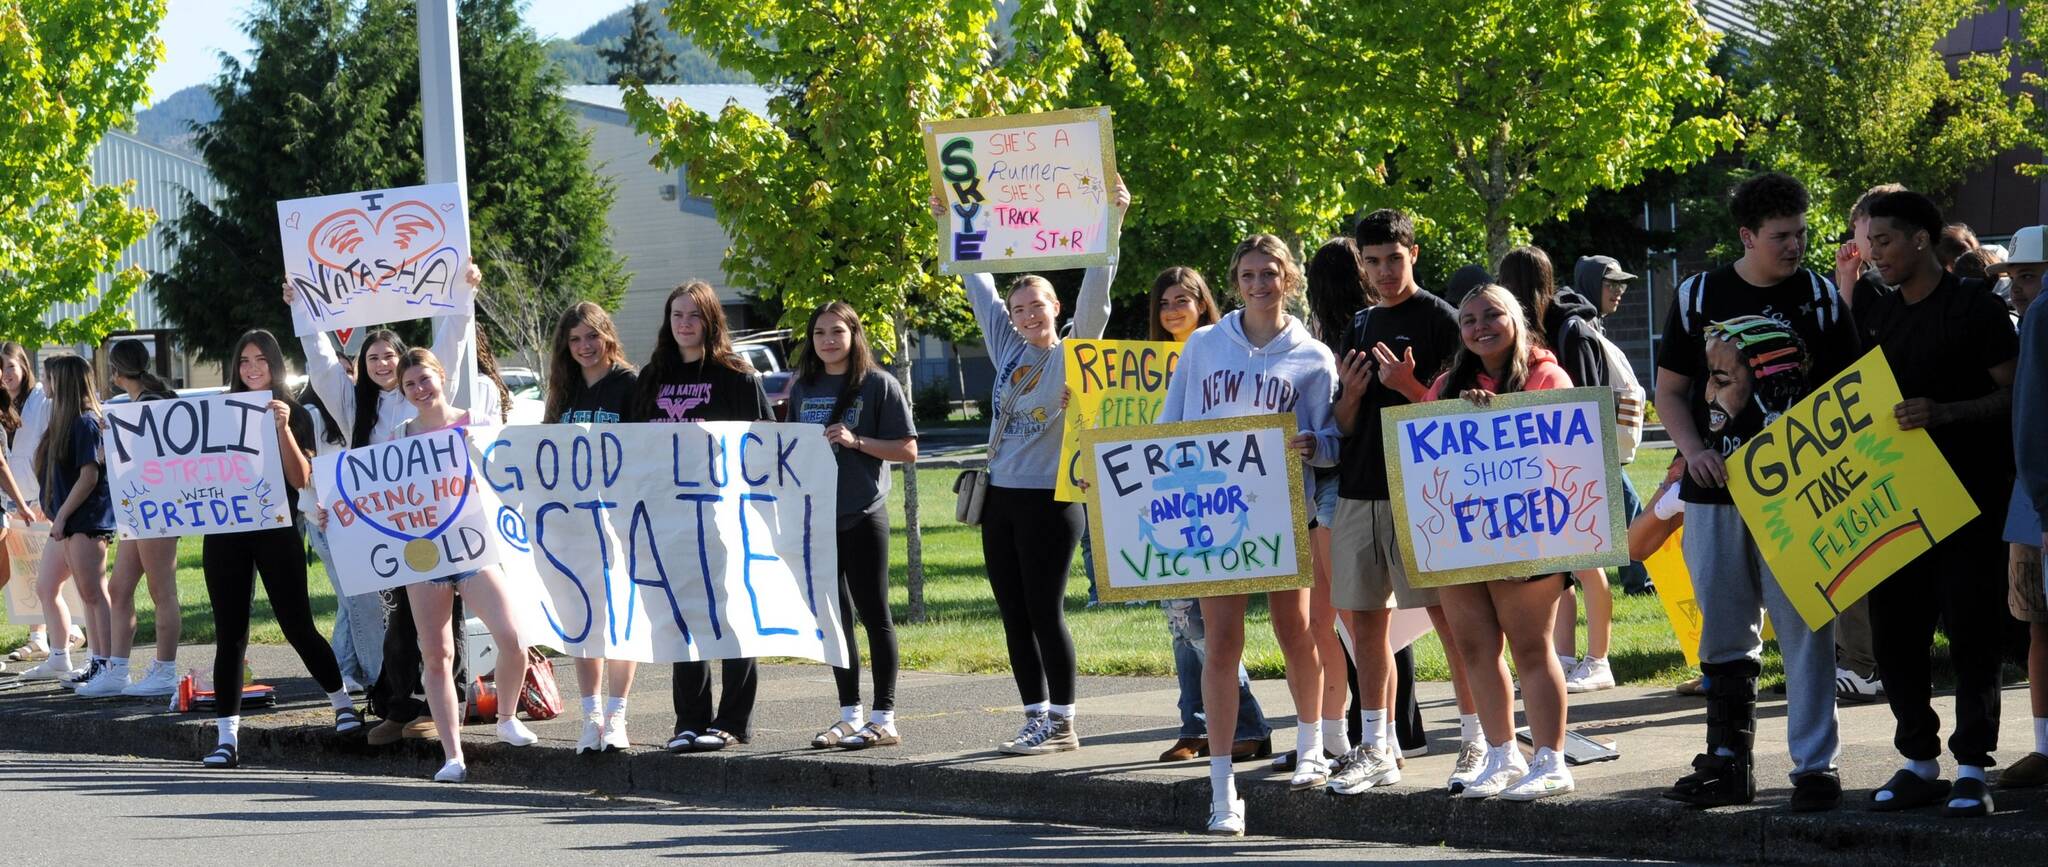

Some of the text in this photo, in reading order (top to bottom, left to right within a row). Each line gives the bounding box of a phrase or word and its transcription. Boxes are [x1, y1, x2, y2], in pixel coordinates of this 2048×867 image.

[988, 129, 1070, 156] SHE'S A
[988, 160, 1072, 183] Runner
[1000, 183, 1072, 204] SHE'S A
[361, 193, 384, 211] I
[941, 136, 988, 262] SKYE
[994, 207, 1040, 226] TRACK
[294, 257, 451, 312] NATASHA
[1201, 369, 1245, 415] NEW
[106, 398, 269, 464] MOLI
[1406, 408, 1594, 464] KAREENA
[1744, 370, 1873, 497] GAGE
[139, 455, 253, 485] STRIDE
[346, 435, 458, 491] NOAH
[482, 432, 801, 492] GOOD LUCK
[1102, 433, 1267, 497] ERIKA
[1463, 456, 1543, 487] SHOTS
[180, 487, 225, 501] WITH
[332, 482, 425, 528] BRING
[1150, 484, 1249, 524] ANCHOR
[1795, 456, 1868, 519] TAKE
[139, 495, 253, 532] PRIDE
[387, 505, 438, 531] THE
[1180, 524, 1215, 548] TO
[1453, 486, 1570, 543] FIRED
[1808, 472, 1902, 571] FLIGHT
[371, 527, 485, 578] GOLD
[1120, 532, 1282, 581] VICTORY
